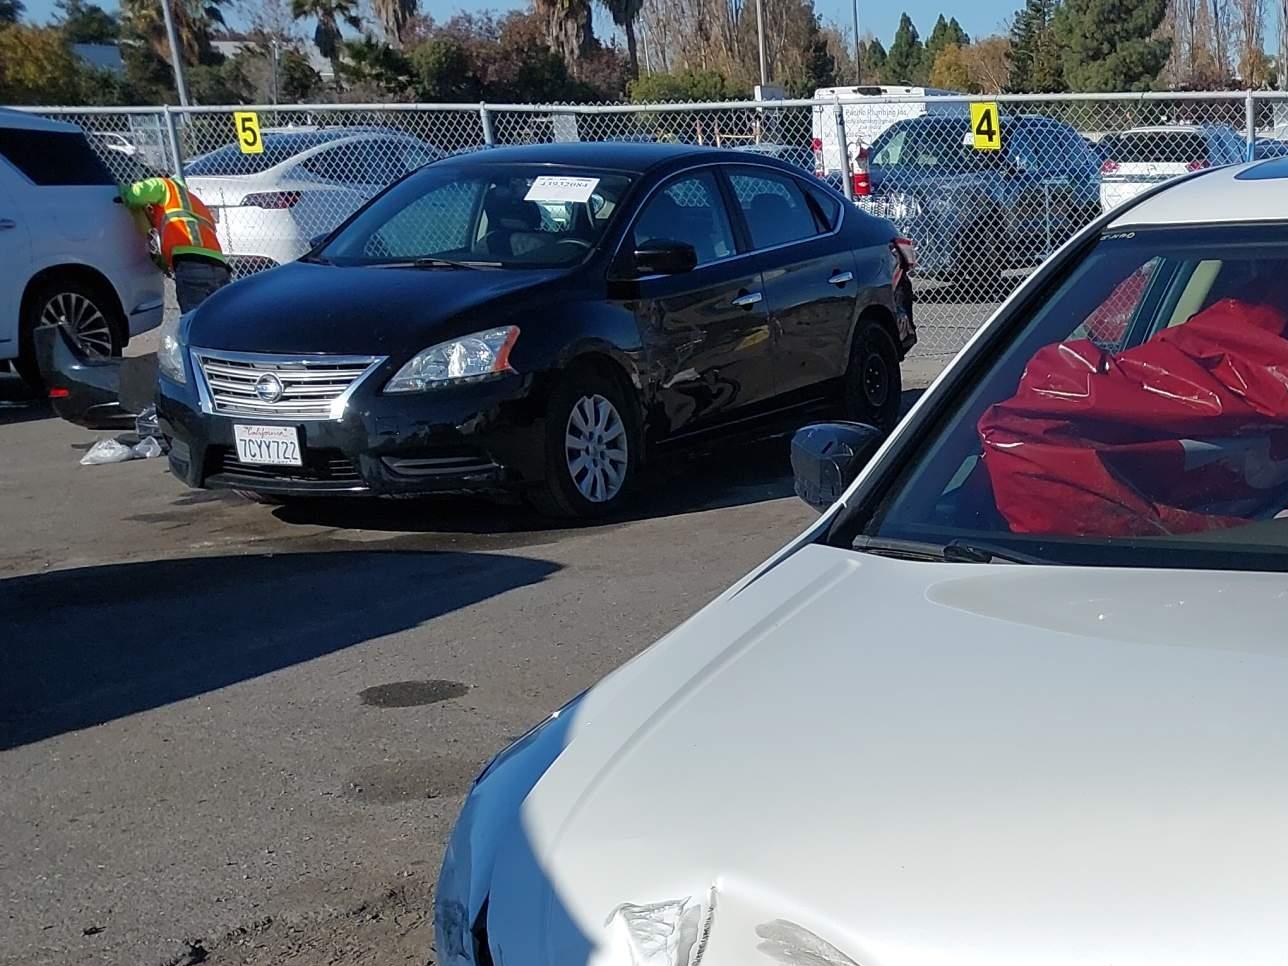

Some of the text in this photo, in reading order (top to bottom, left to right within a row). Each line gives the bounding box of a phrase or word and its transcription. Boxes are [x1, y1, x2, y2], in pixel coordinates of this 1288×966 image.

[241, 117, 258, 147] 5
[976, 108, 997, 142] 4
[240, 439, 299, 460] 7CYY722
